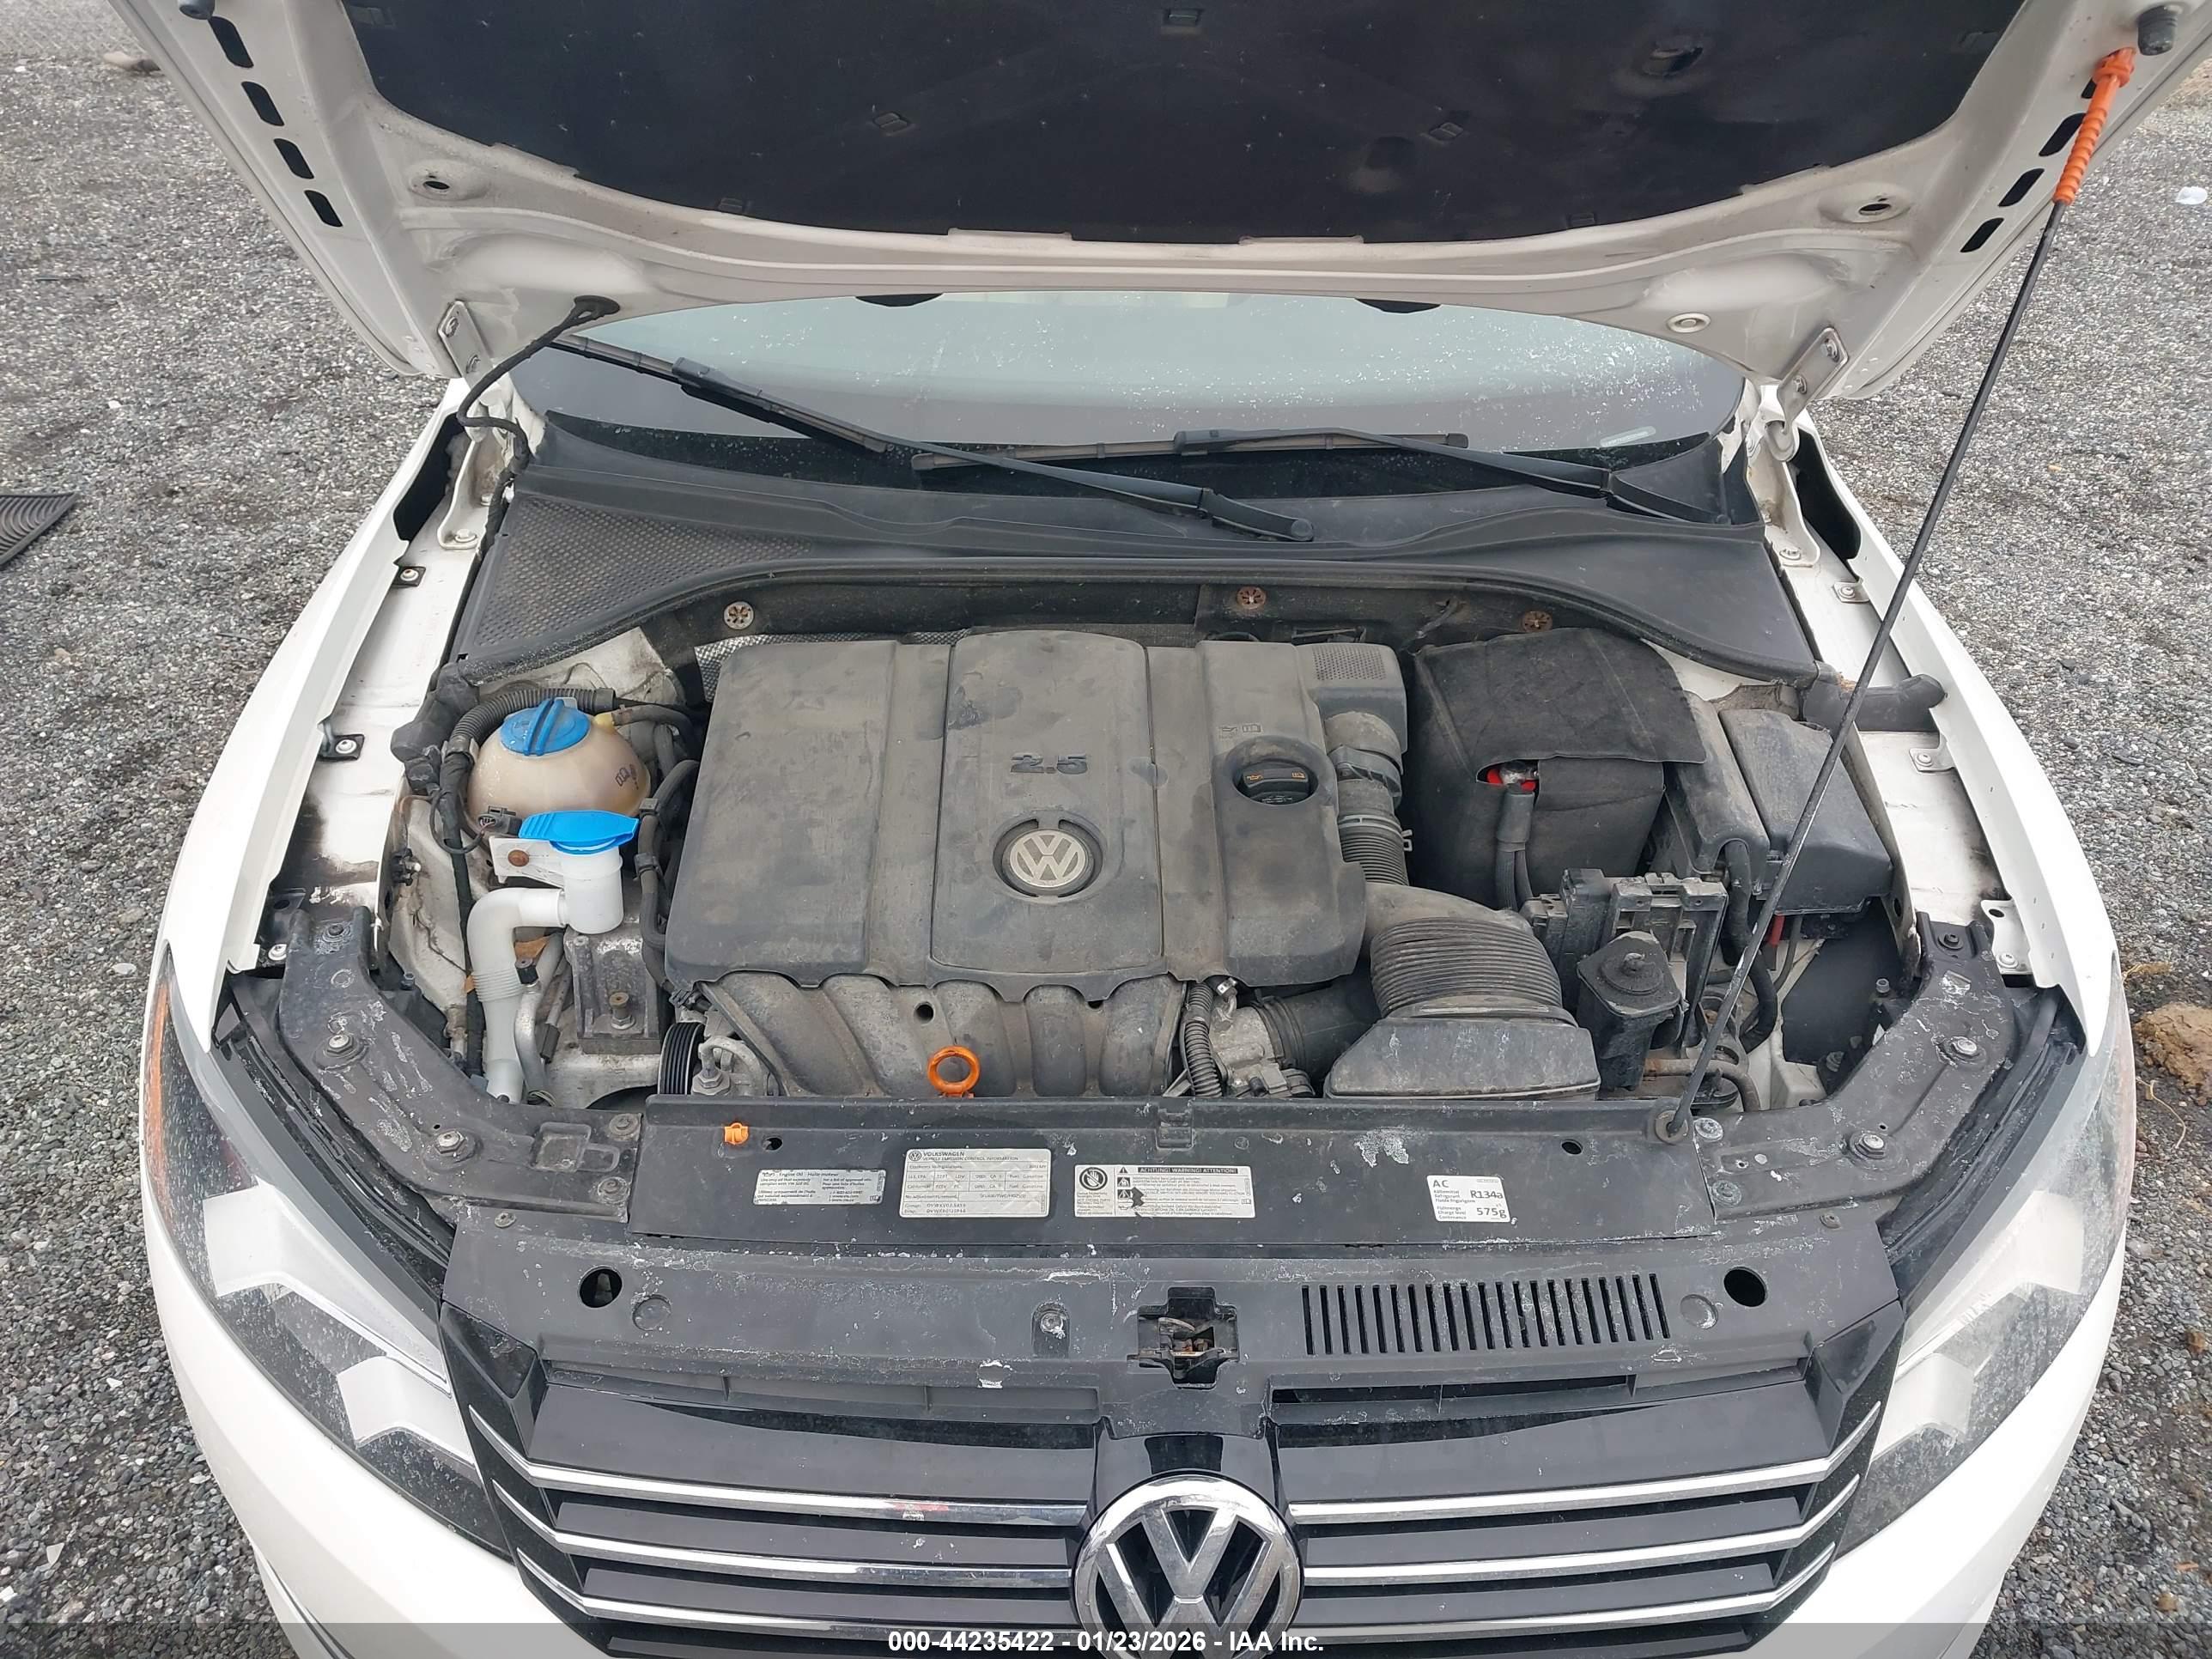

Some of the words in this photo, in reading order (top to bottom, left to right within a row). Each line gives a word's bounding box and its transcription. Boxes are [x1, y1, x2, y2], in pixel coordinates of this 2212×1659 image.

[1011, 755, 1088, 775] 2.5
[1470, 1190, 1504, 1200] R134a
[1476, 1207, 1508, 1219] 575g
